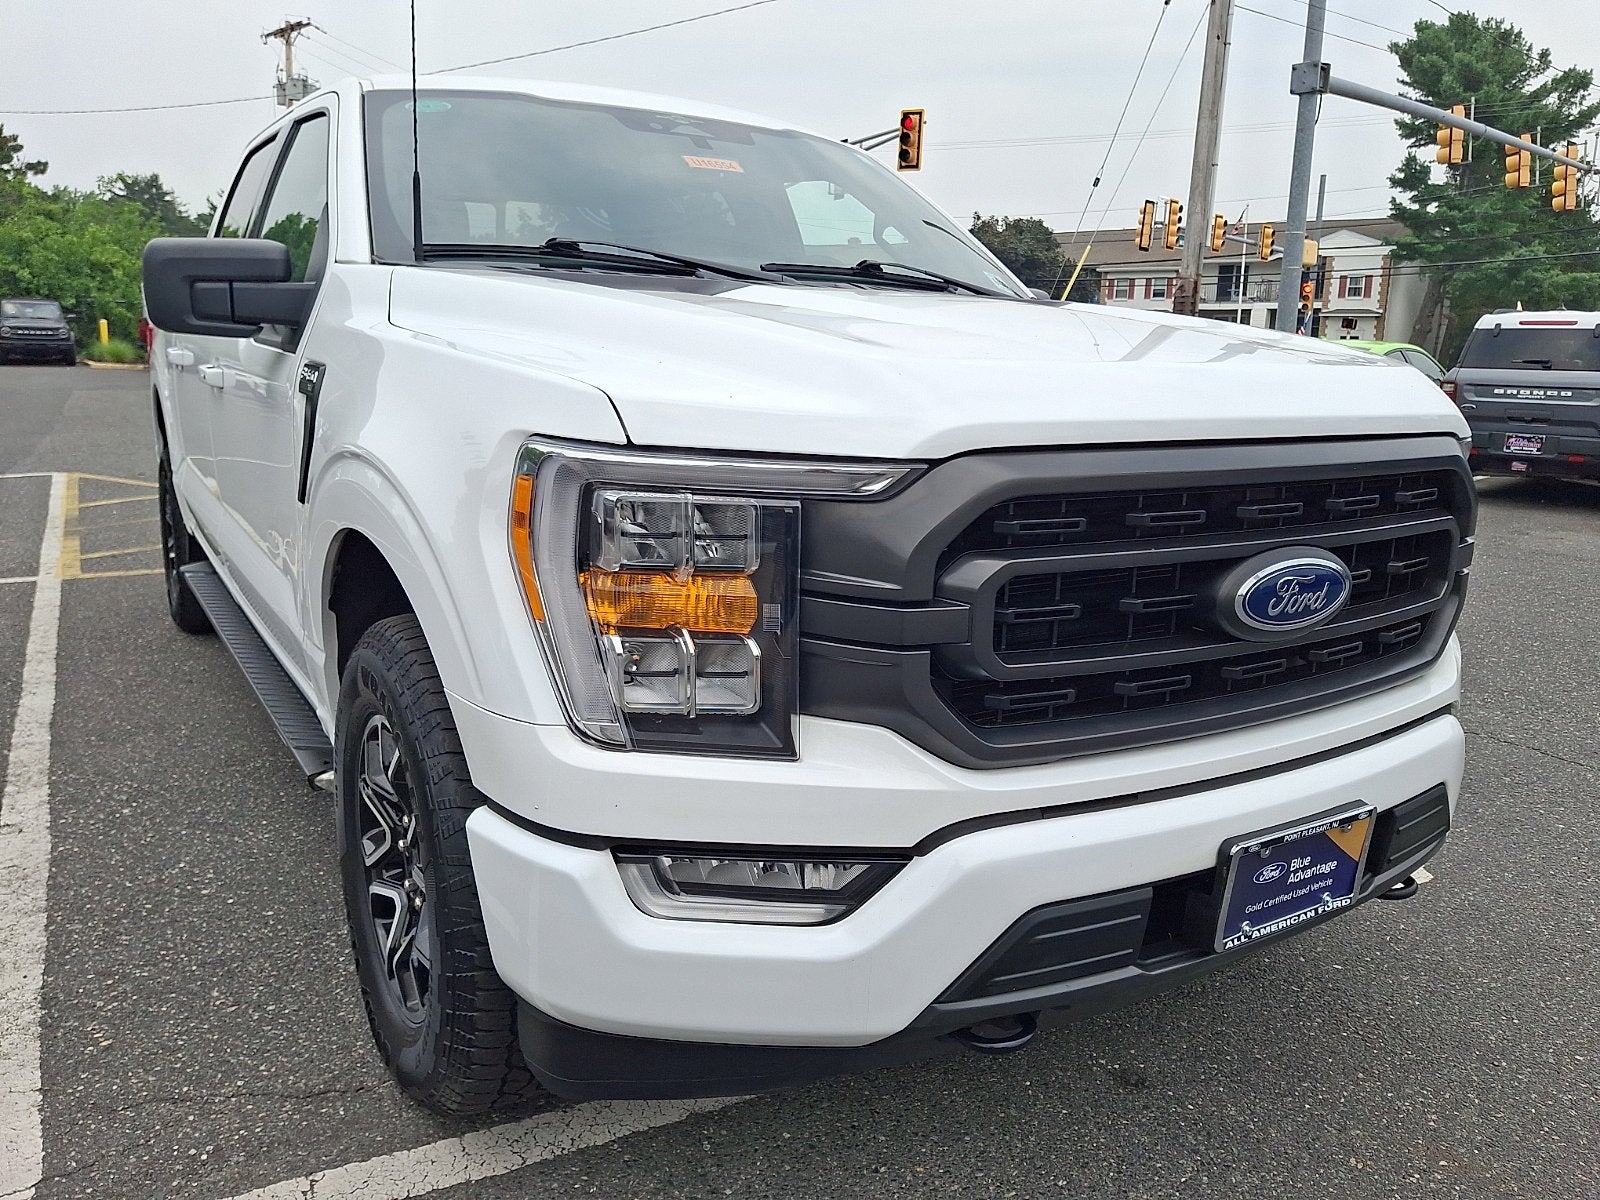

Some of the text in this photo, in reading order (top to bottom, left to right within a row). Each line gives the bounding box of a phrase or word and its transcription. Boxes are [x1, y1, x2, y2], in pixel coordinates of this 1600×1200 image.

[1493, 388, 1573, 397] BRONCO
[1267, 574, 1331, 617] Ford
[1283, 831, 1302, 843] POINT
[1331, 820, 1340, 828] NJ
[1259, 865, 1282, 882] Ford
[1287, 860, 1338, 885] Advantage
[1290, 856, 1311, 871] Blue
[1245, 878, 1334, 914] Gold Certified Used Vehicle
[1224, 898, 1351, 949] ALL AMERICAN FORD
